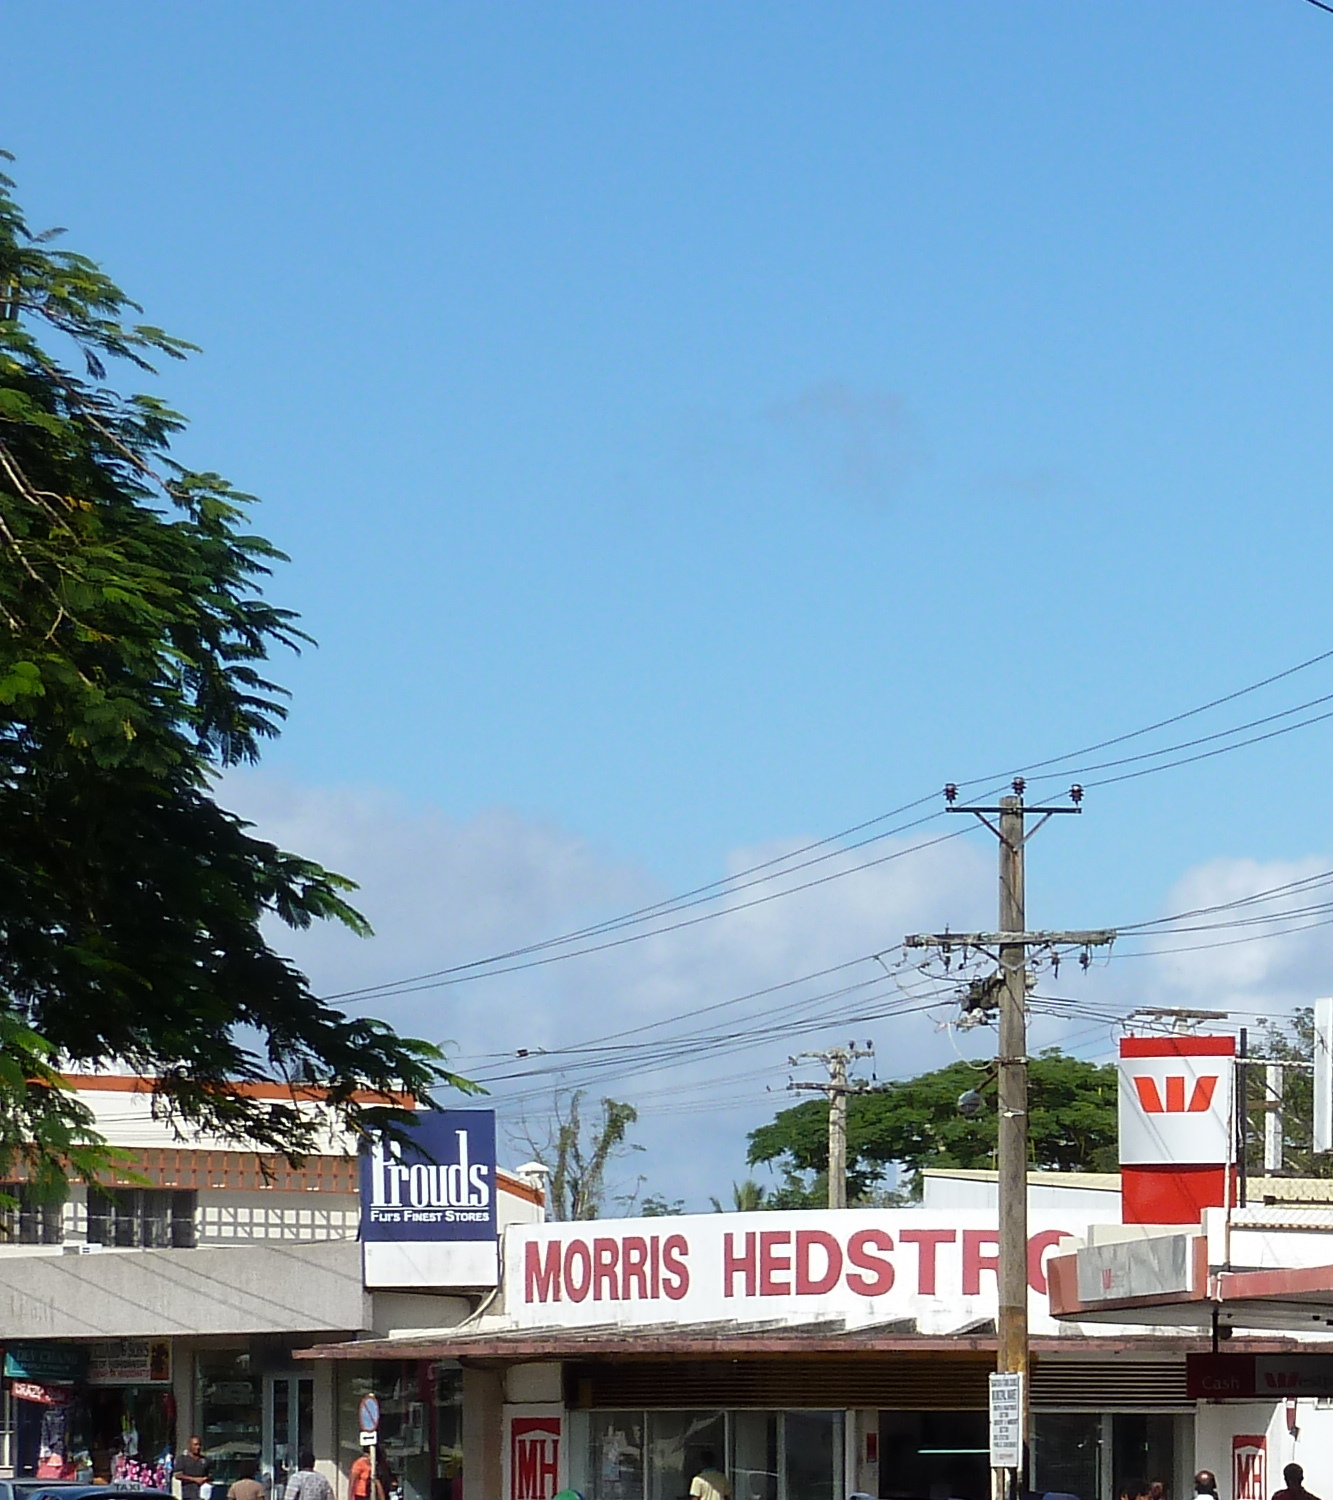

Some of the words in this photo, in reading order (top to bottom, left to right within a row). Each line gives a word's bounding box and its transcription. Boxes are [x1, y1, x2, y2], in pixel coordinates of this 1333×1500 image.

[524, 1234, 690, 1303] MORRIS
[1202, 1376, 1240, 1390] Cash
[114, 1483, 140, 1491] TAXI
